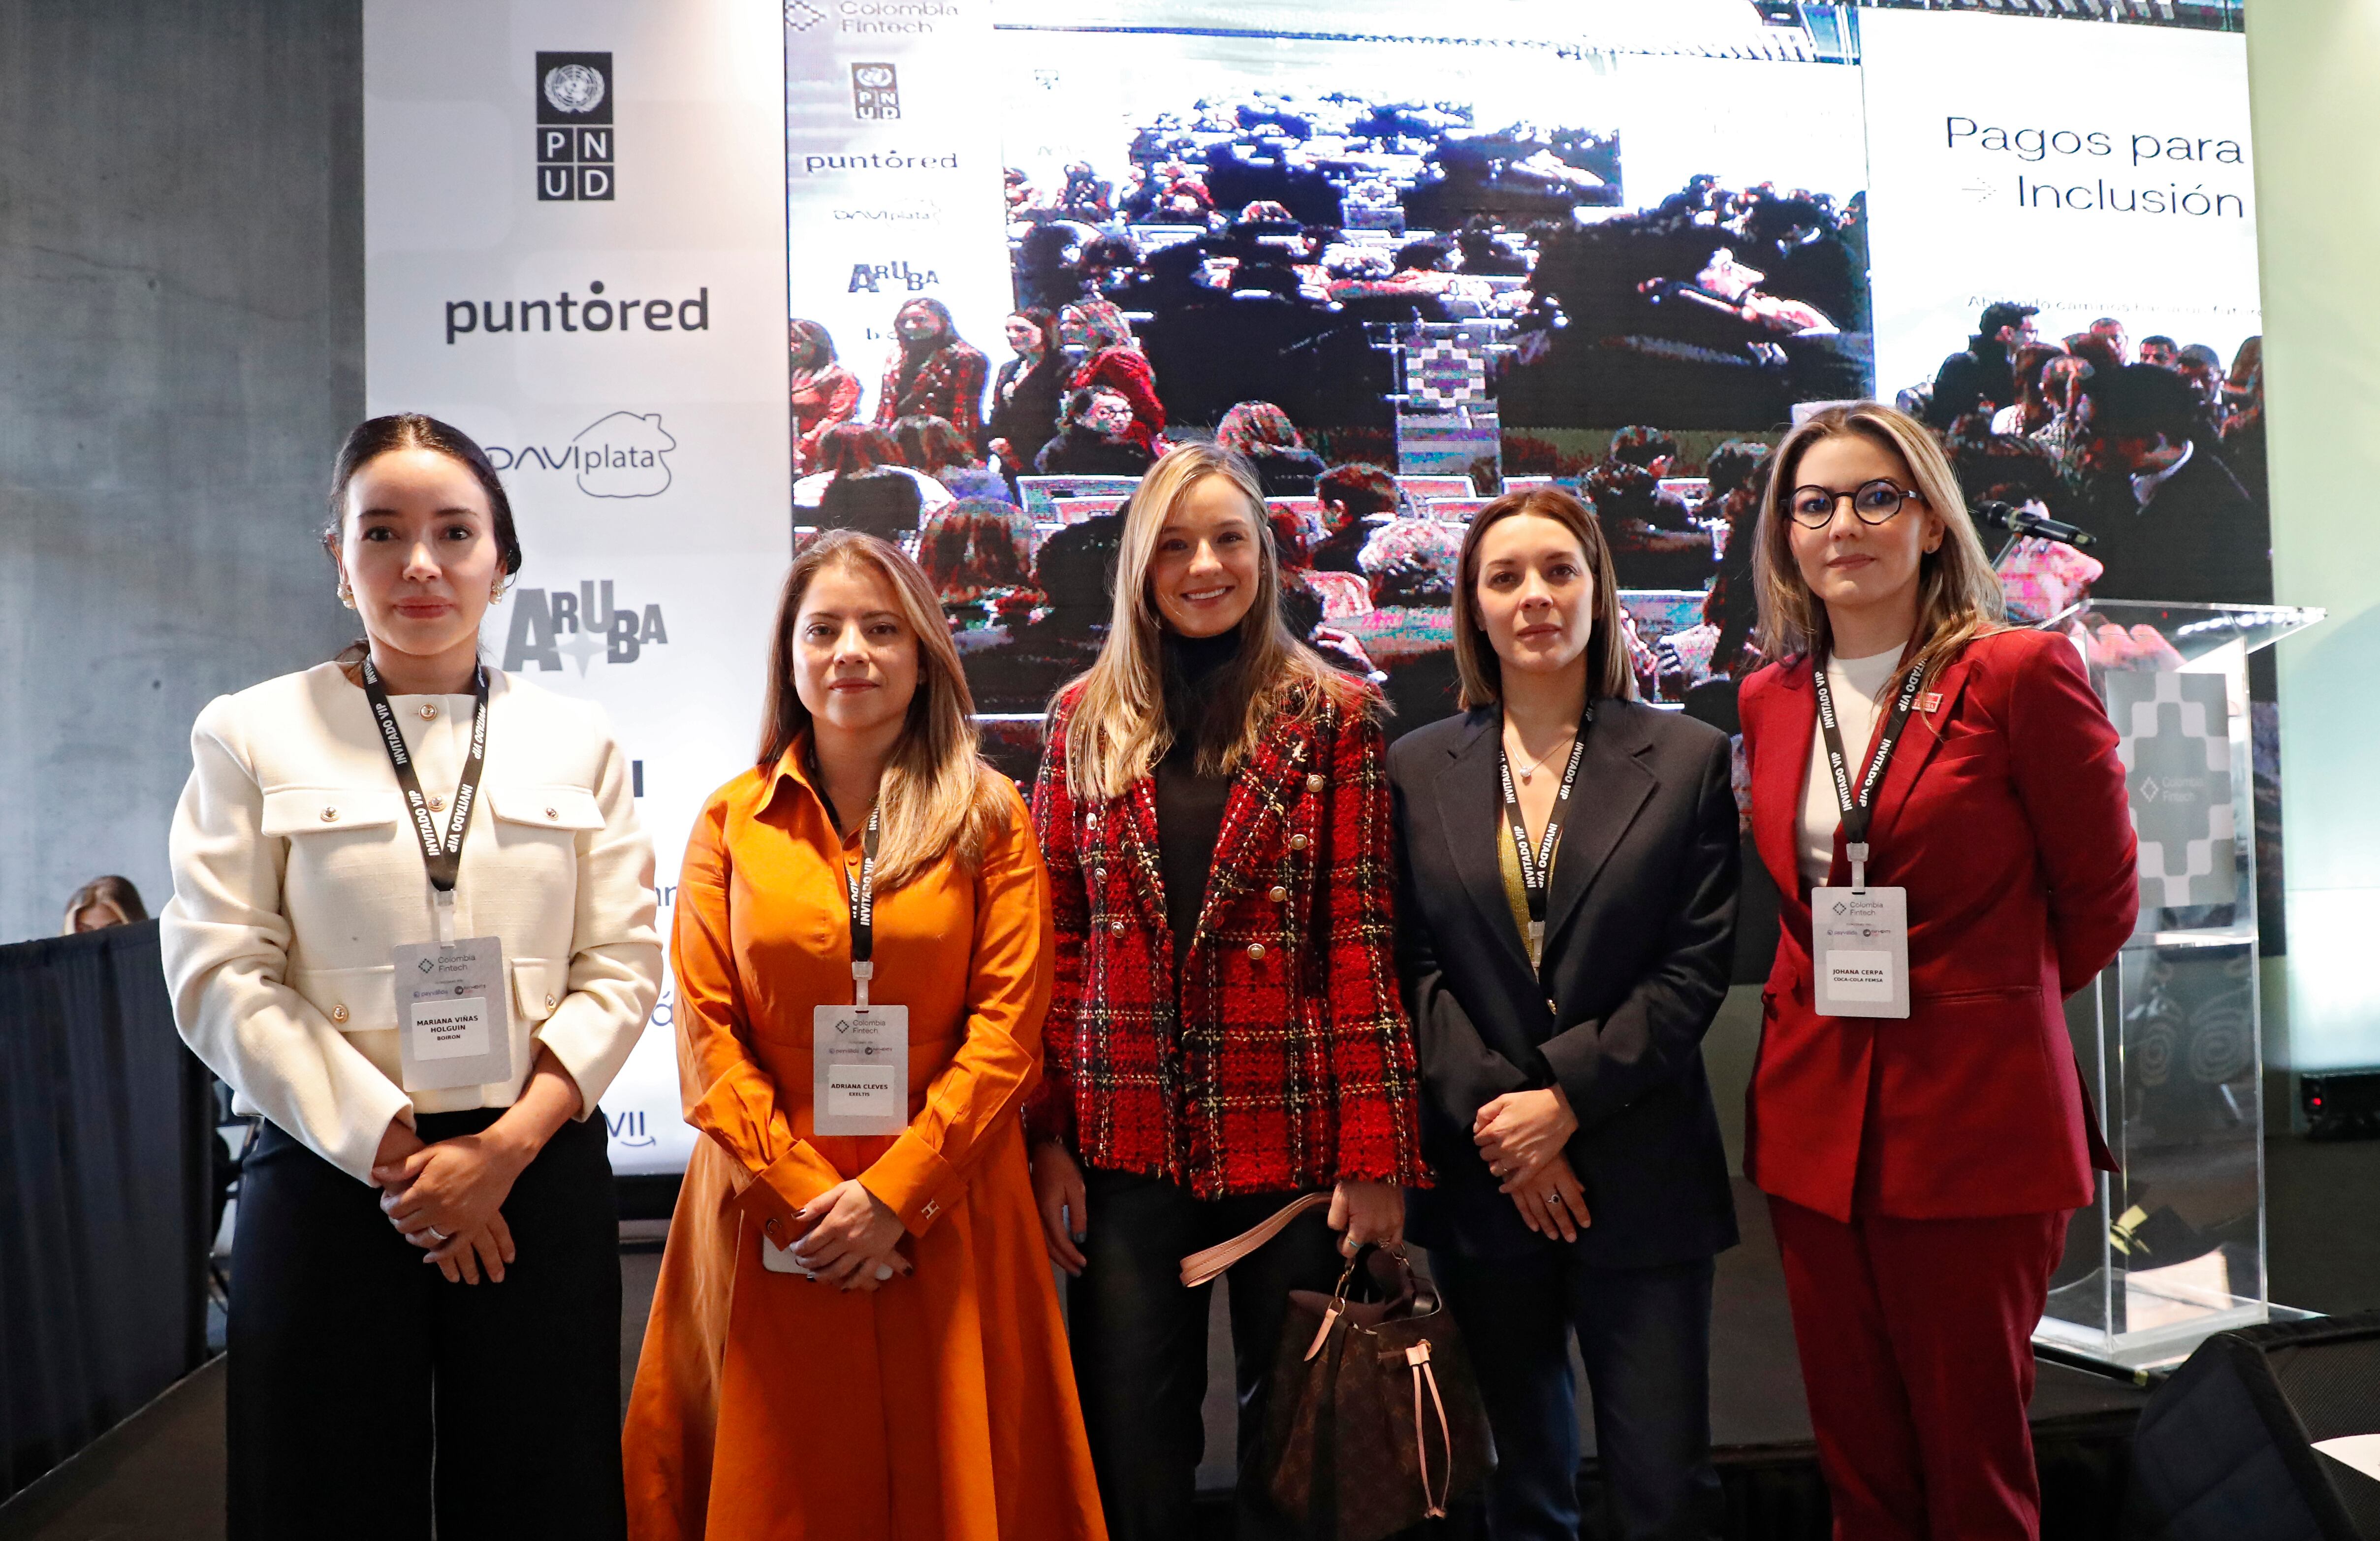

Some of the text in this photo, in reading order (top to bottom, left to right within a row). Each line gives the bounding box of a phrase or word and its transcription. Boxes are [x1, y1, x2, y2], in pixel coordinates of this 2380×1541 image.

[1946, 116, 2244, 166] Pagos para
[2018, 175, 2244, 218] Inclusión
[848, 261, 940, 293] ARUBA
[502, 579, 668, 672] ARUBA
[1815, 671, 1835, 729] INVITADO VIP
[1898, 694, 1912, 712] VIP
[376, 703, 408, 765] INVITADO VIP
[472, 703, 486, 760] INVITADO VIP
[1560, 741, 1585, 800] INVITADO VIP
[1831, 752, 1853, 811] INVITADO VIP
[1859, 738, 1892, 807] INVITADO VIP
[408, 790, 441, 856] INVITADO VIP
[446, 783, 473, 853] INVITADO VIP
[1514, 826, 1537, 888] INVITADO VIP
[1537, 823, 1558, 888] INVITADO VIP
[438, 954, 476, 963] Colombia
[438, 963, 468, 972] Fintech
[416, 1014, 478, 1027] MARIANA VIÑAS
[430, 1024, 466, 1033] HOLGUIN
